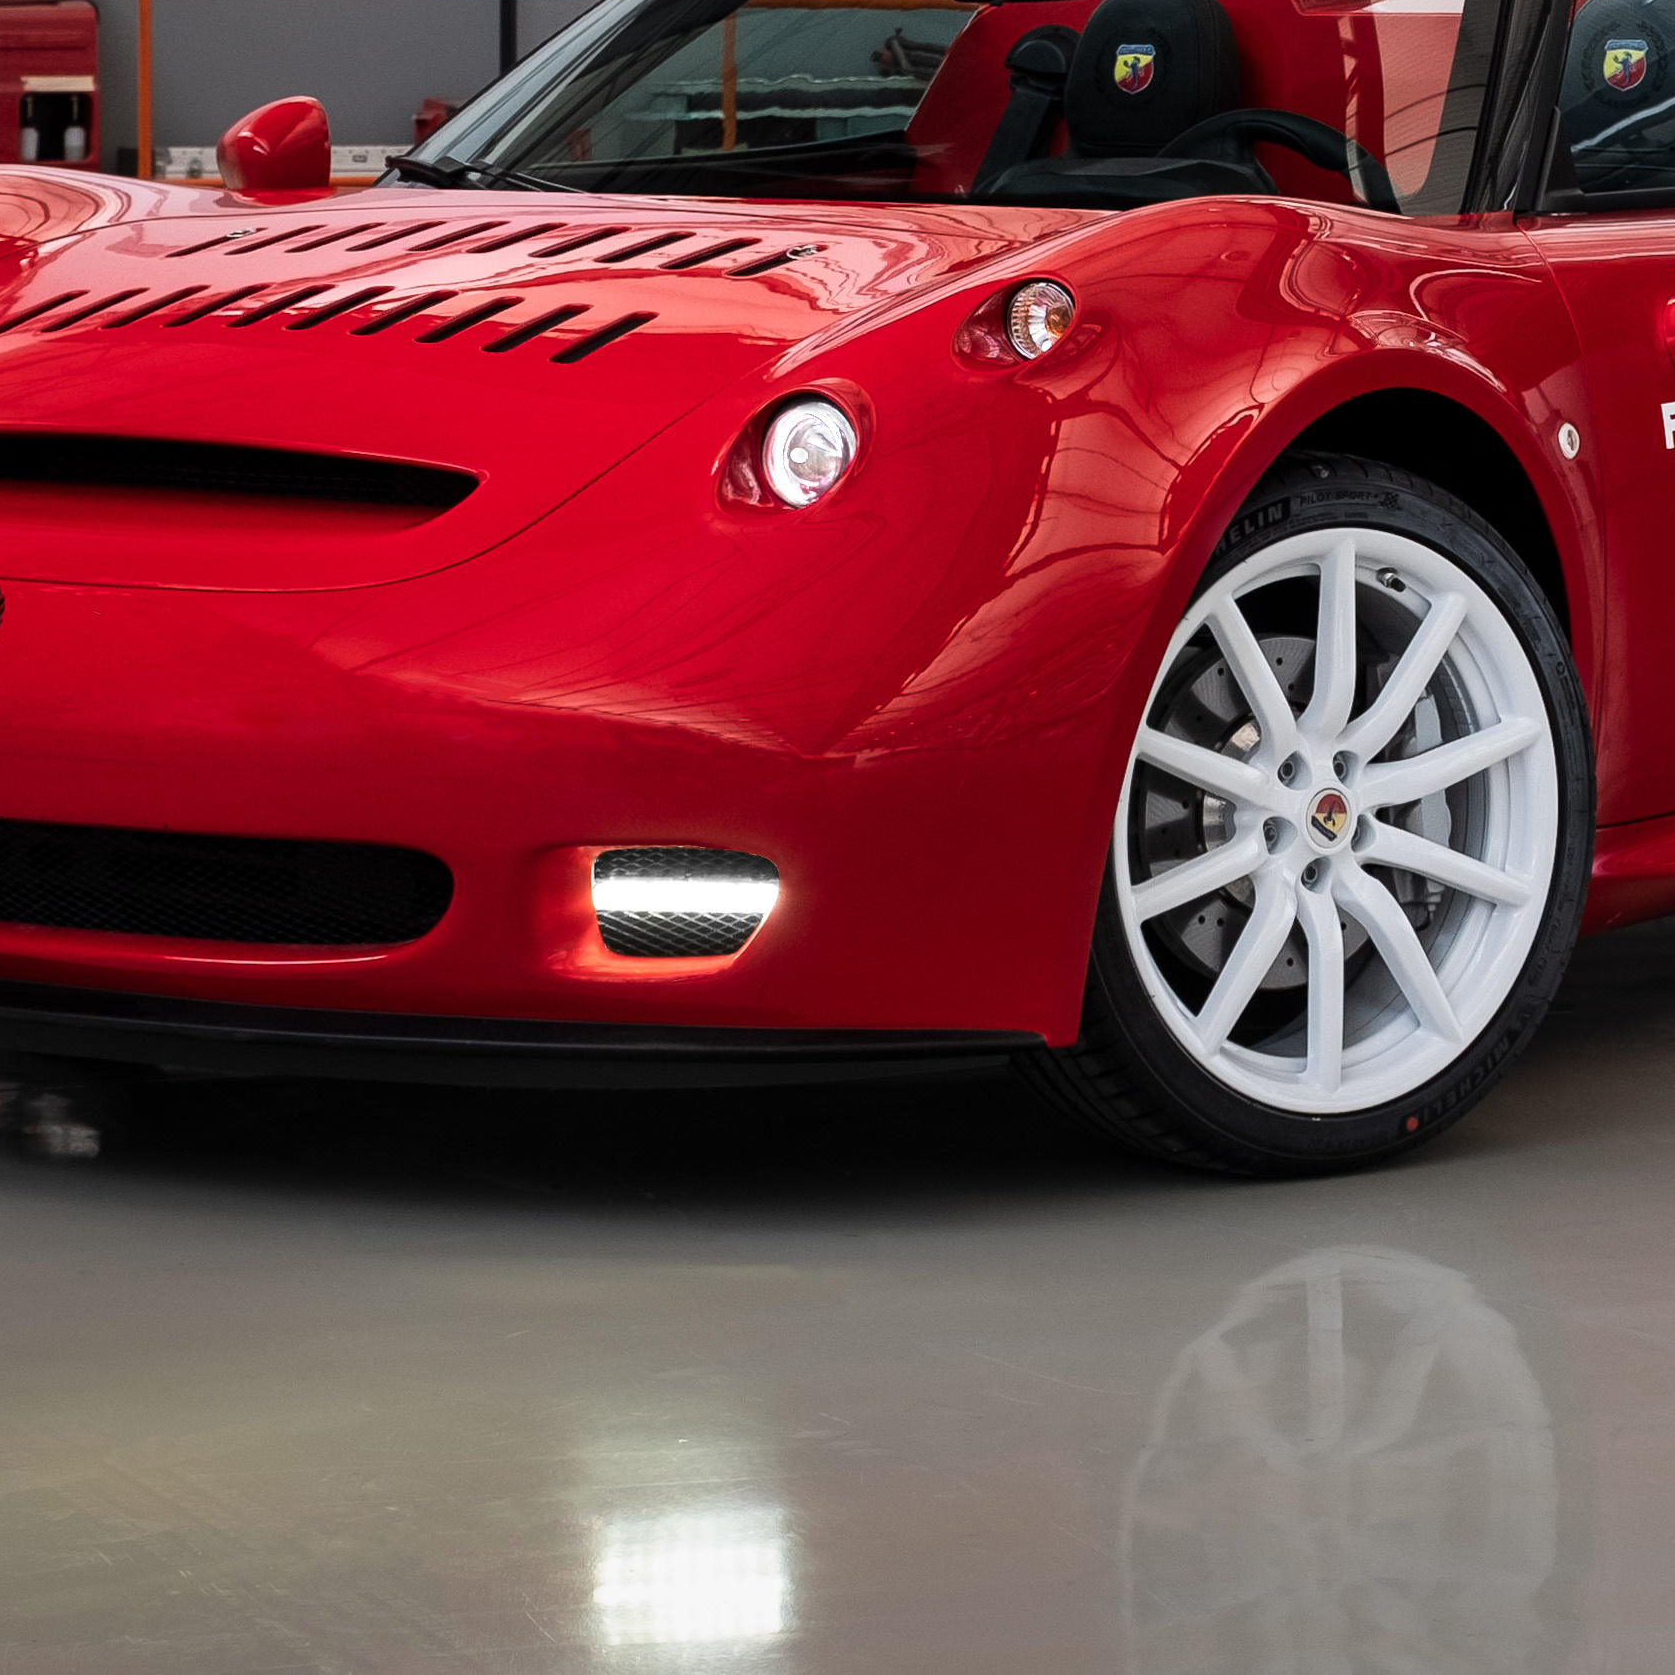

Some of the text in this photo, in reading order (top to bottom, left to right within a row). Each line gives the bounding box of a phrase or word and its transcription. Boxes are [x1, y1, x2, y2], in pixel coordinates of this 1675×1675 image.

[1300, 491, 1331, 507] PILOT
[1335, 490, 1371, 501] SPORT
[1406, 1036, 1510, 1132] MICHELI
